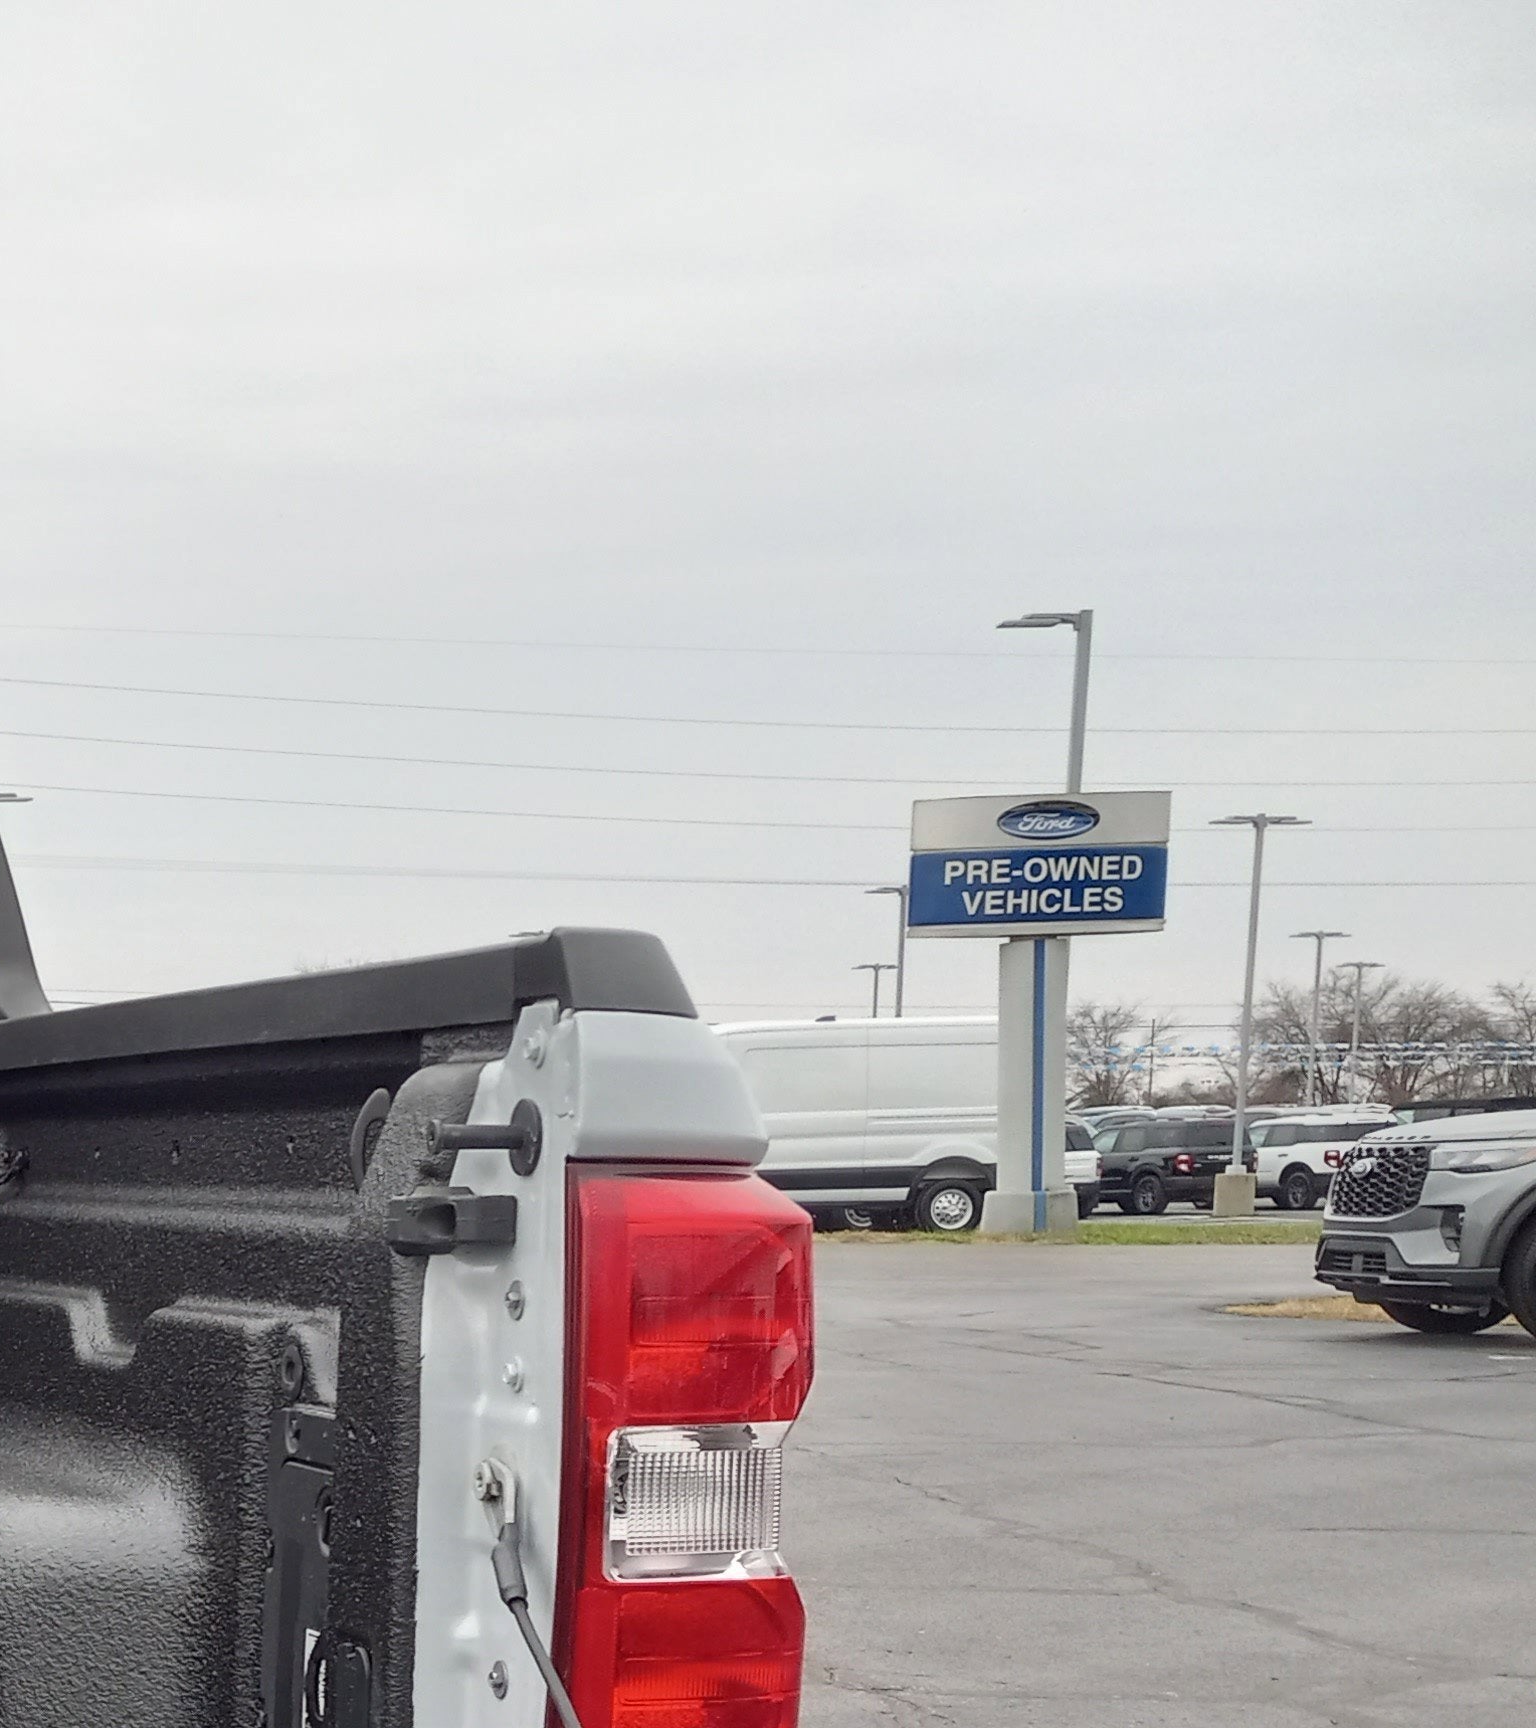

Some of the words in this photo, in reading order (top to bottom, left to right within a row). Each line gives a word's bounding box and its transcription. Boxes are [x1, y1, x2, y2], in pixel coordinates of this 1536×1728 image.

[1018, 812, 1076, 832] Ford
[944, 855, 1143, 886] PRE-OWNED
[961, 887, 1124, 916] VEHICLES
